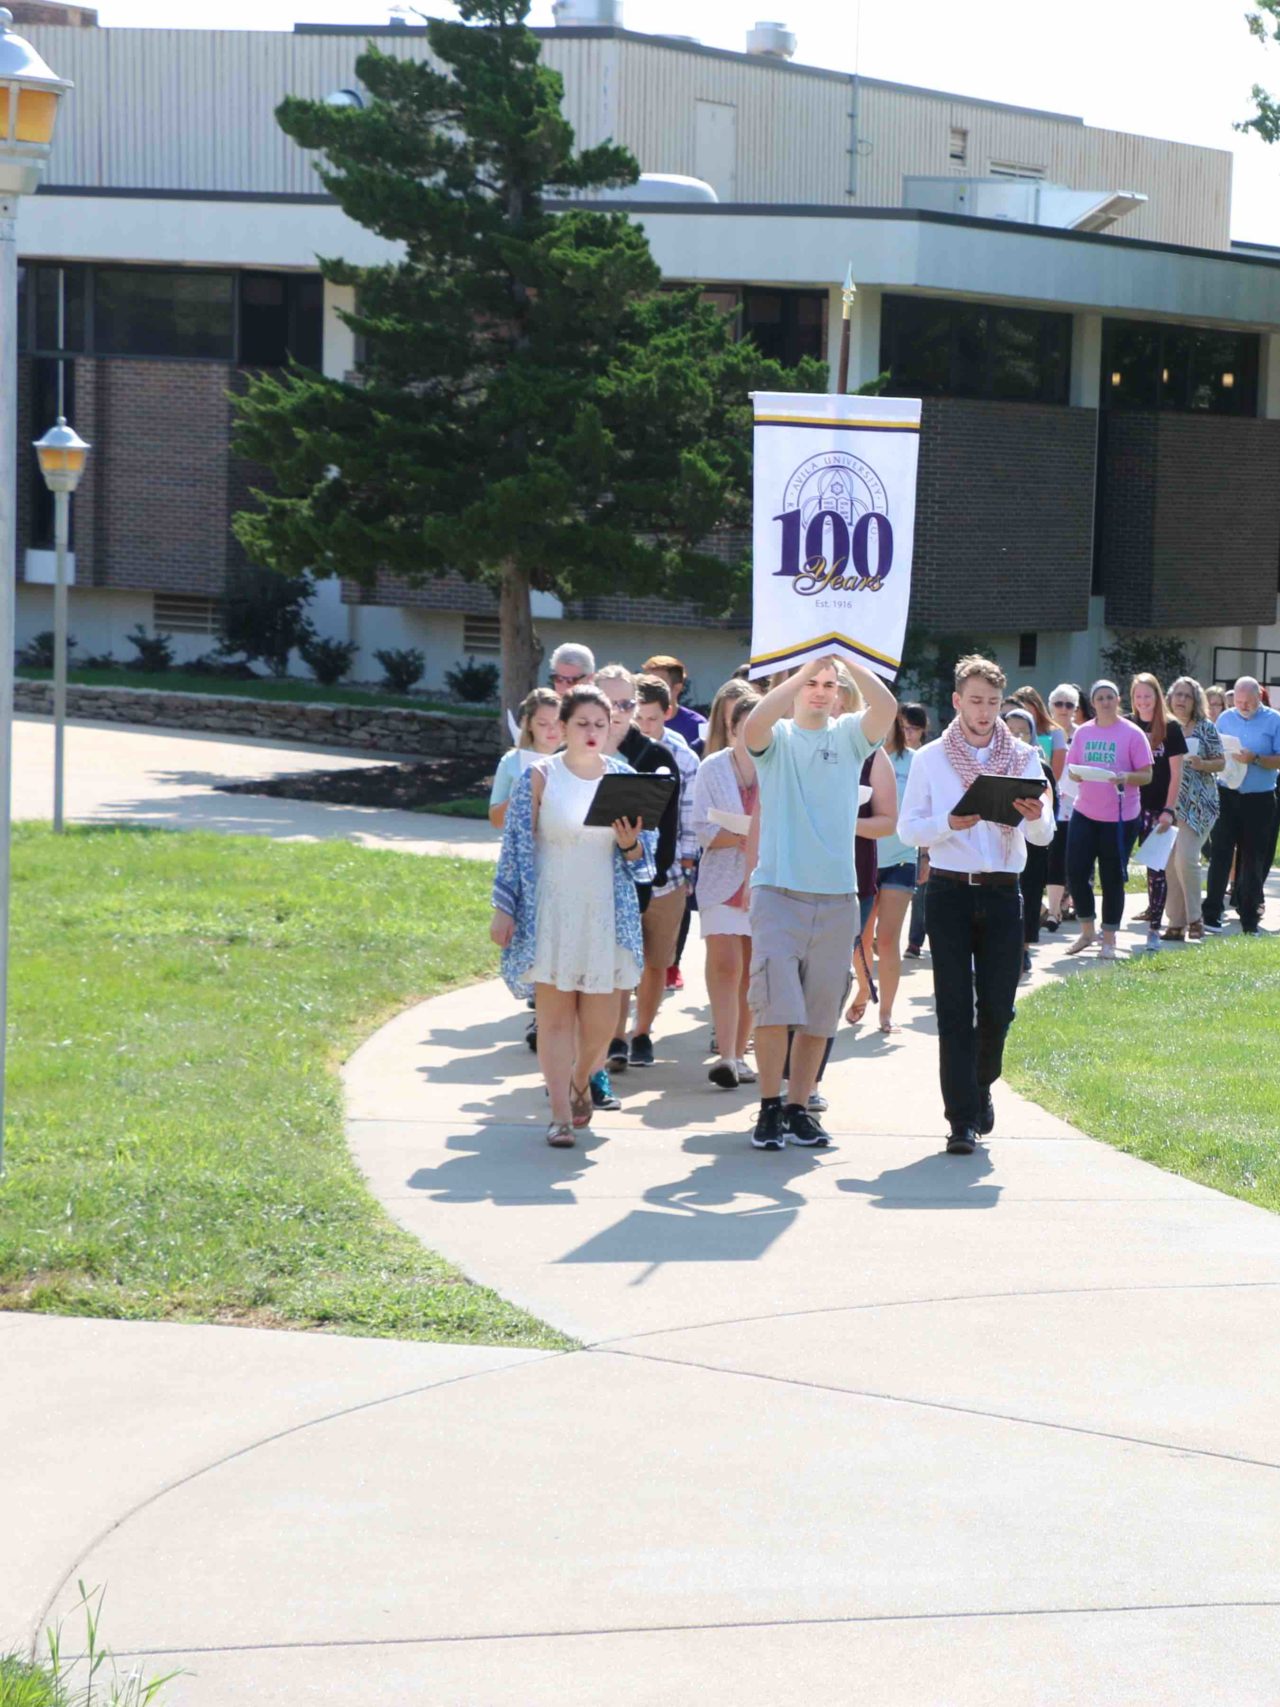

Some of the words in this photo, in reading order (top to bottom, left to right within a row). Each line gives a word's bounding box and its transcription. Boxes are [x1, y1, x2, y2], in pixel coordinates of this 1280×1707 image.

[792, 463, 818, 490] AVILA
[823, 456, 883, 495] UNIVERSITY
[772, 508, 894, 577] 100
[792, 555, 884, 595] Years
[815, 599, 830, 608] Est.
[833, 599, 852, 609] 1916
[1085, 741, 1116, 752] AVILA
